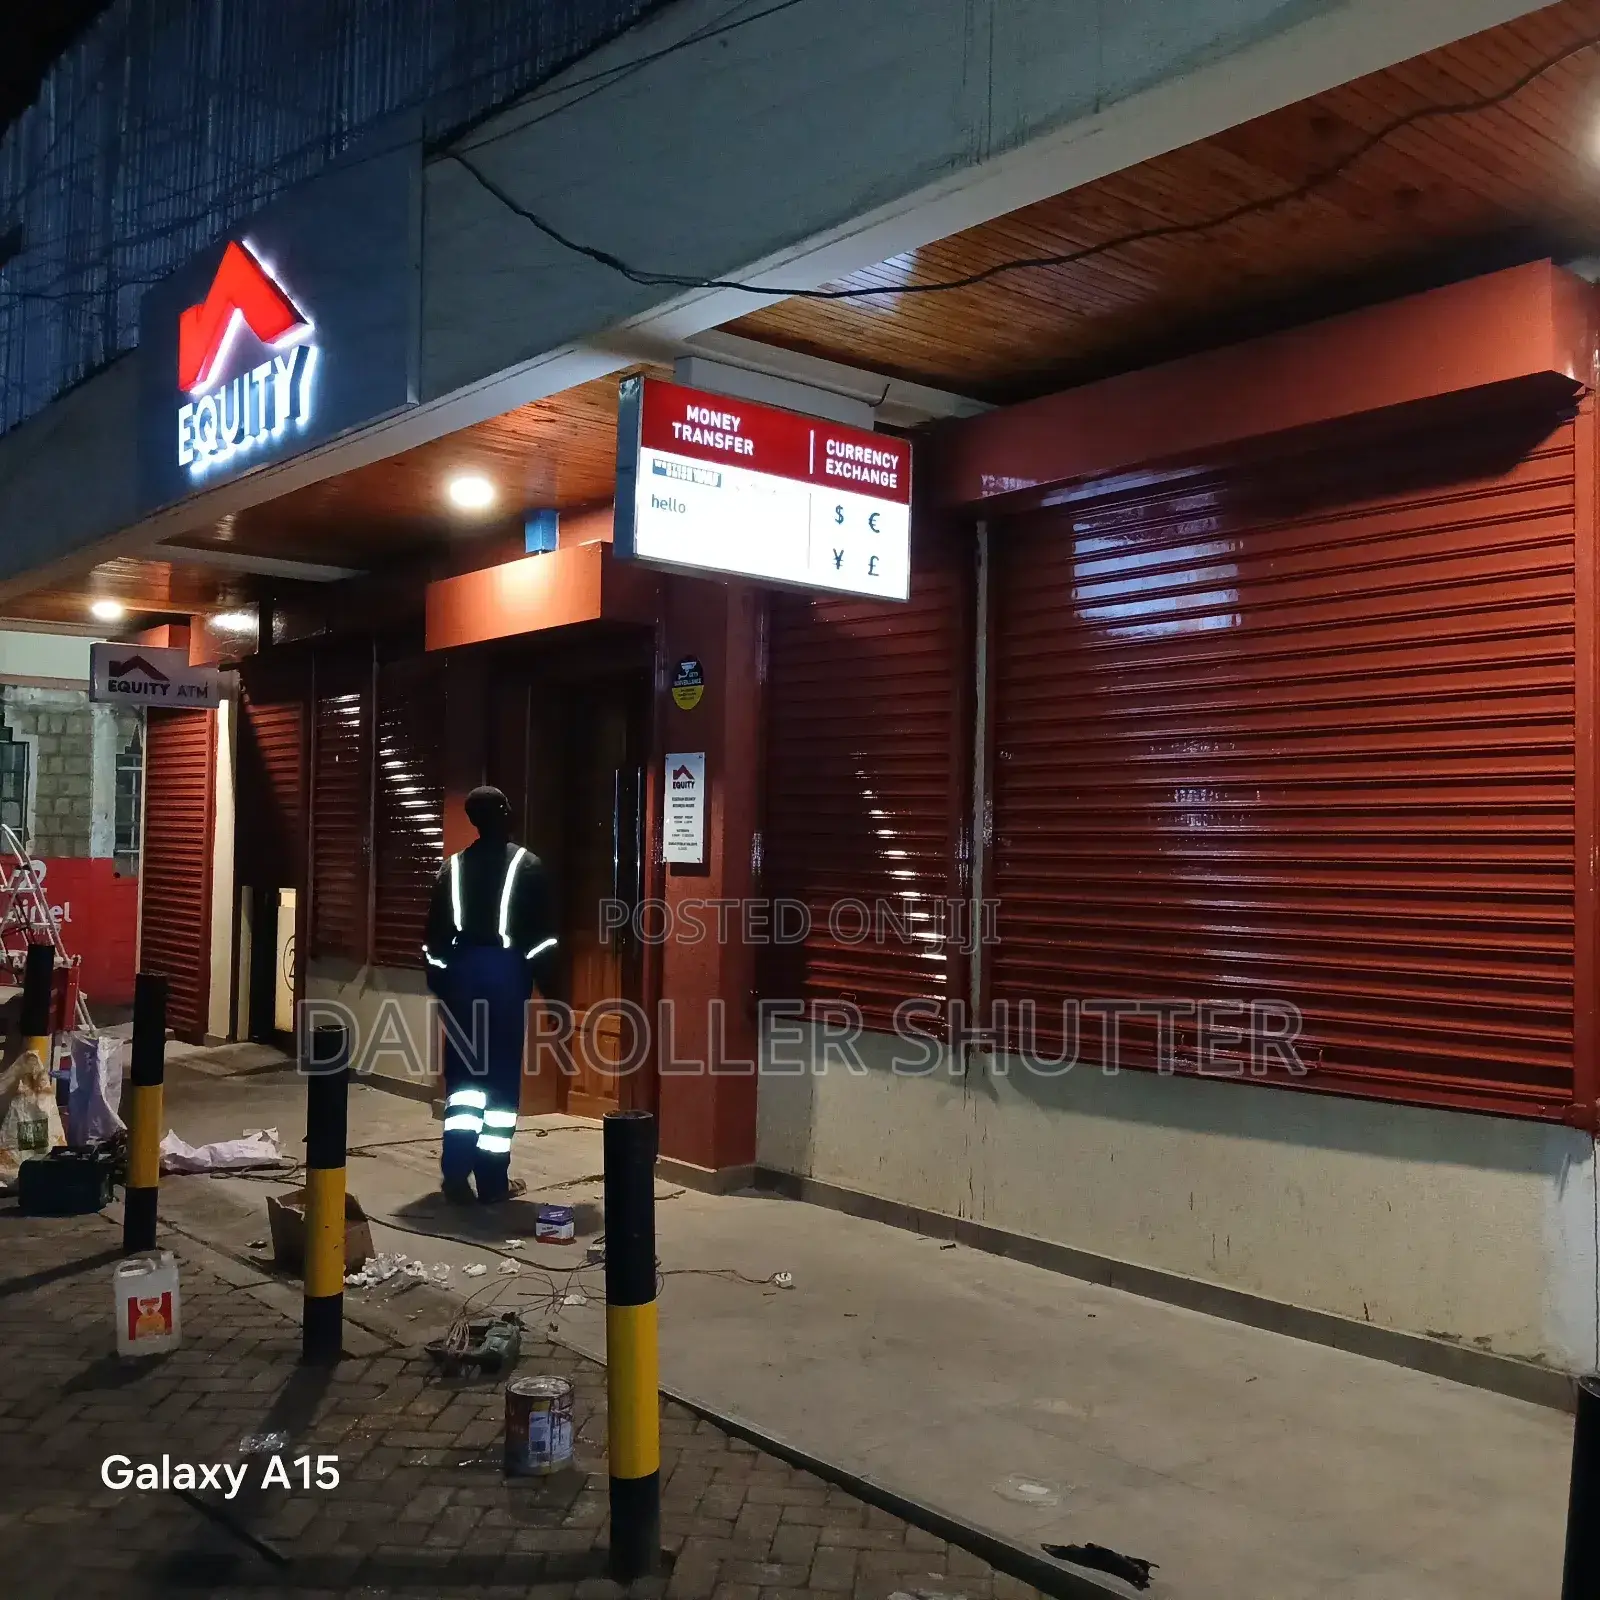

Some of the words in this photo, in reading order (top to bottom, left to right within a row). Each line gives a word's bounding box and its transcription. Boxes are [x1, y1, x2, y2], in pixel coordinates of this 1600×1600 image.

[178, 345, 318, 471] EQUITY
[686, 404, 741, 432] MONEY
[672, 422, 754, 455] TRANSFER
[825, 439, 899, 469] CURRENCY
[825, 458, 898, 488] EXCHANGE
[651, 493, 686, 514] hello
[834, 505, 844, 525] $
[868, 512, 881, 533] €
[833, 548, 844, 570] ¥
[867, 555, 880, 576] £
[108, 680, 170, 696] EQUITY
[176, 683, 209, 698] ATM
[672, 781, 695, 789] EQUITY
